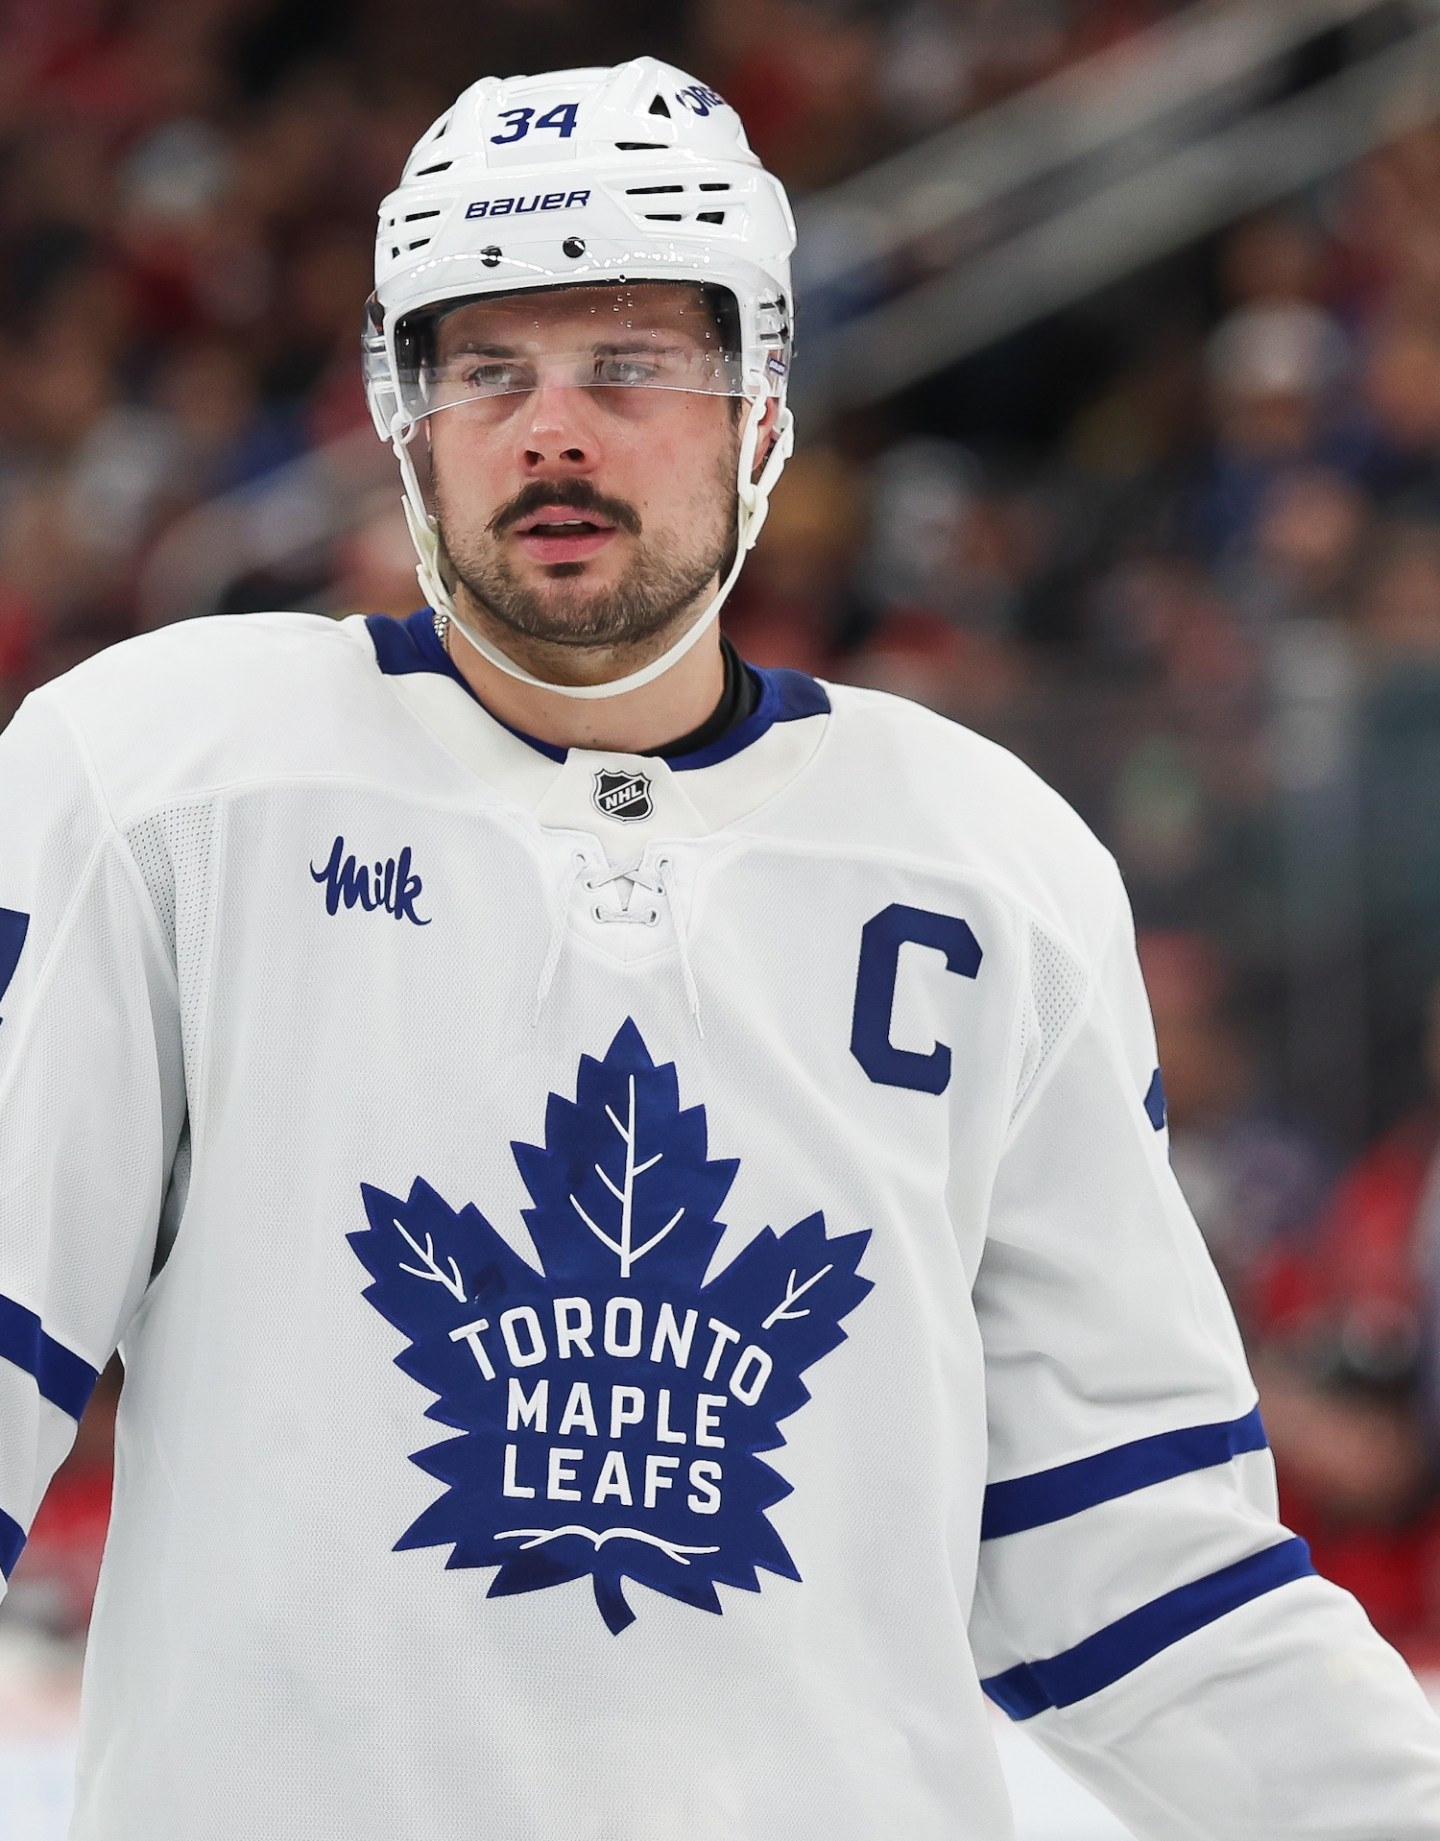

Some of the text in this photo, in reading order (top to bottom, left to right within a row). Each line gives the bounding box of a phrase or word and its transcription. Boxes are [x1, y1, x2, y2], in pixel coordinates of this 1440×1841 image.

[490, 102, 579, 145] 34
[465, 190, 591, 219] BAUER
[605, 784, 642, 810] NHL
[310, 836, 432, 926] Milk
[850, 903, 983, 1096] C
[449, 1296, 773, 1406] TORONTO
[506, 1377, 728, 1448] MAPLE
[502, 1443, 723, 1515] LEAFS
